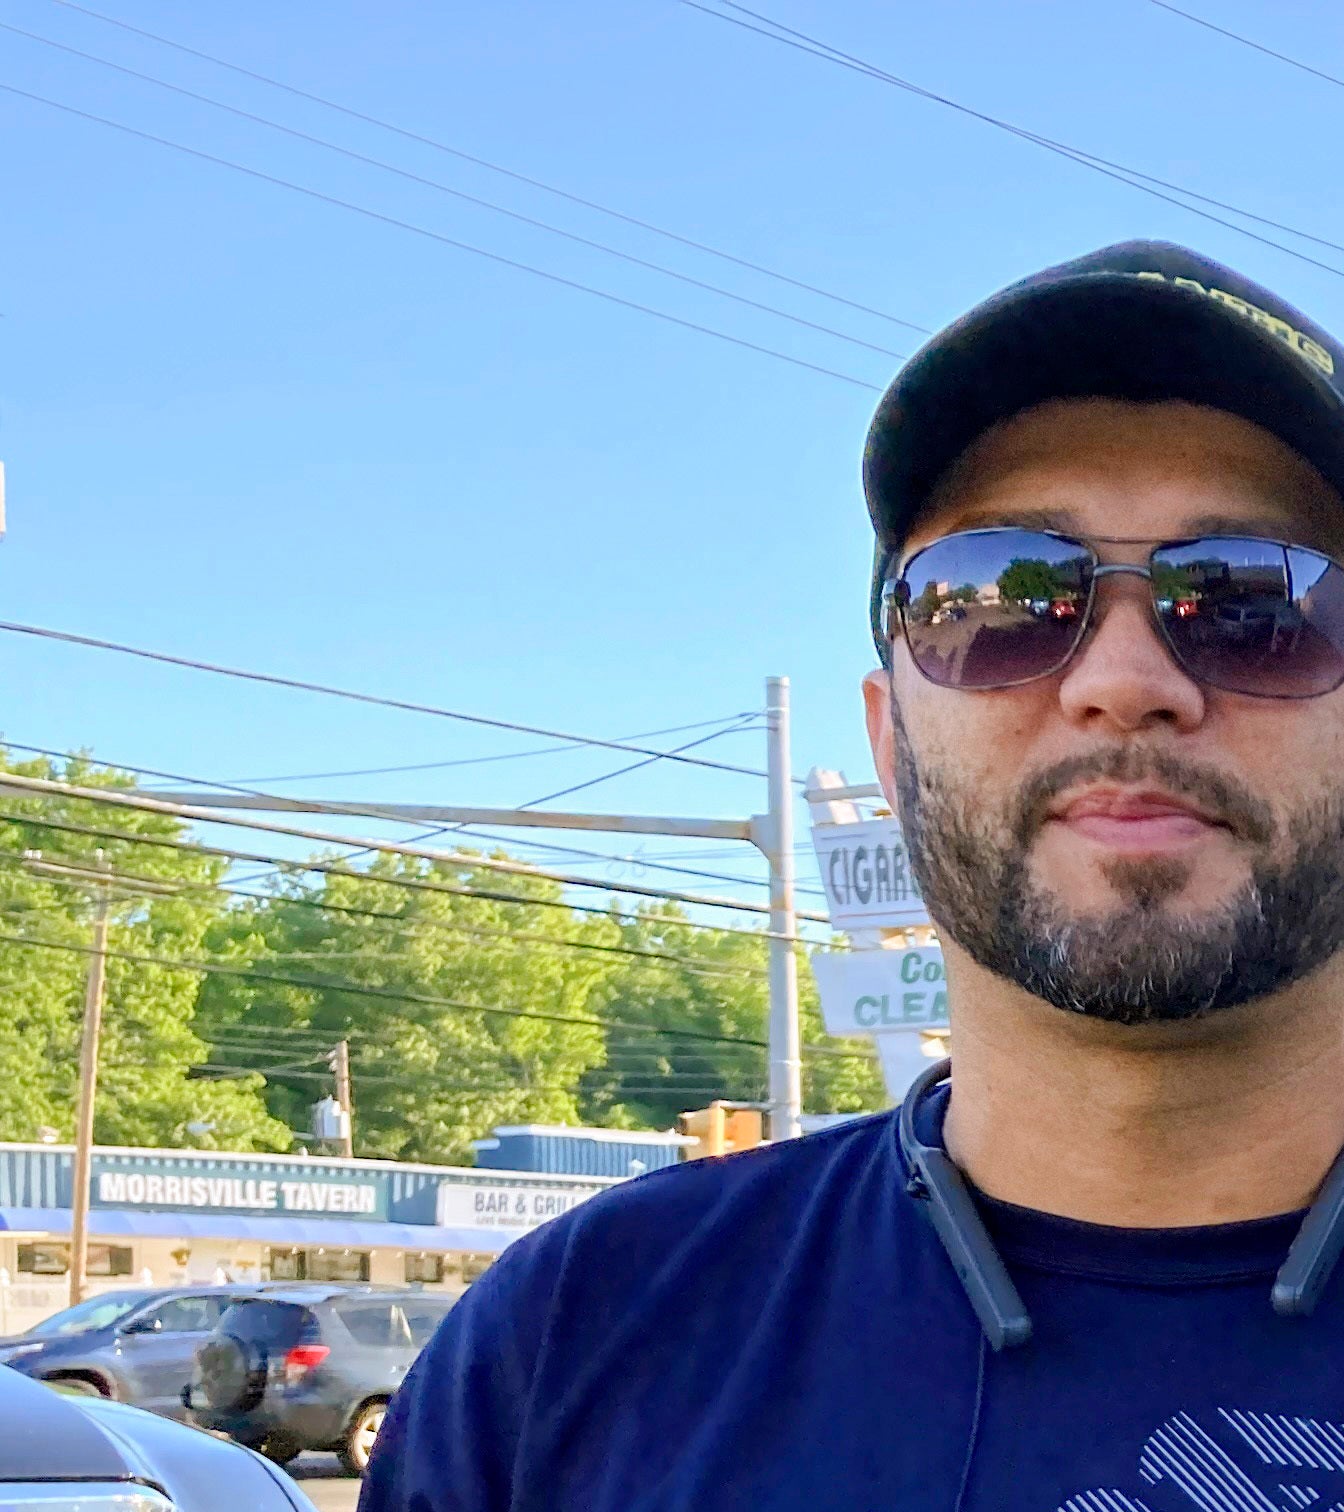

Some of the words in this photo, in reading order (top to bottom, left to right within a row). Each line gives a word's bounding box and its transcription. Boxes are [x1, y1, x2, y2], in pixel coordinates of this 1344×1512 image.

[829, 845, 922, 905] CIGAR
[901, 952, 946, 984] Co
[100, 1172, 278, 1209] MORRISVILLE
[281, 1182, 376, 1213] TAVERN
[474, 1191, 509, 1213] BAR
[515, 1193, 526, 1214] &
